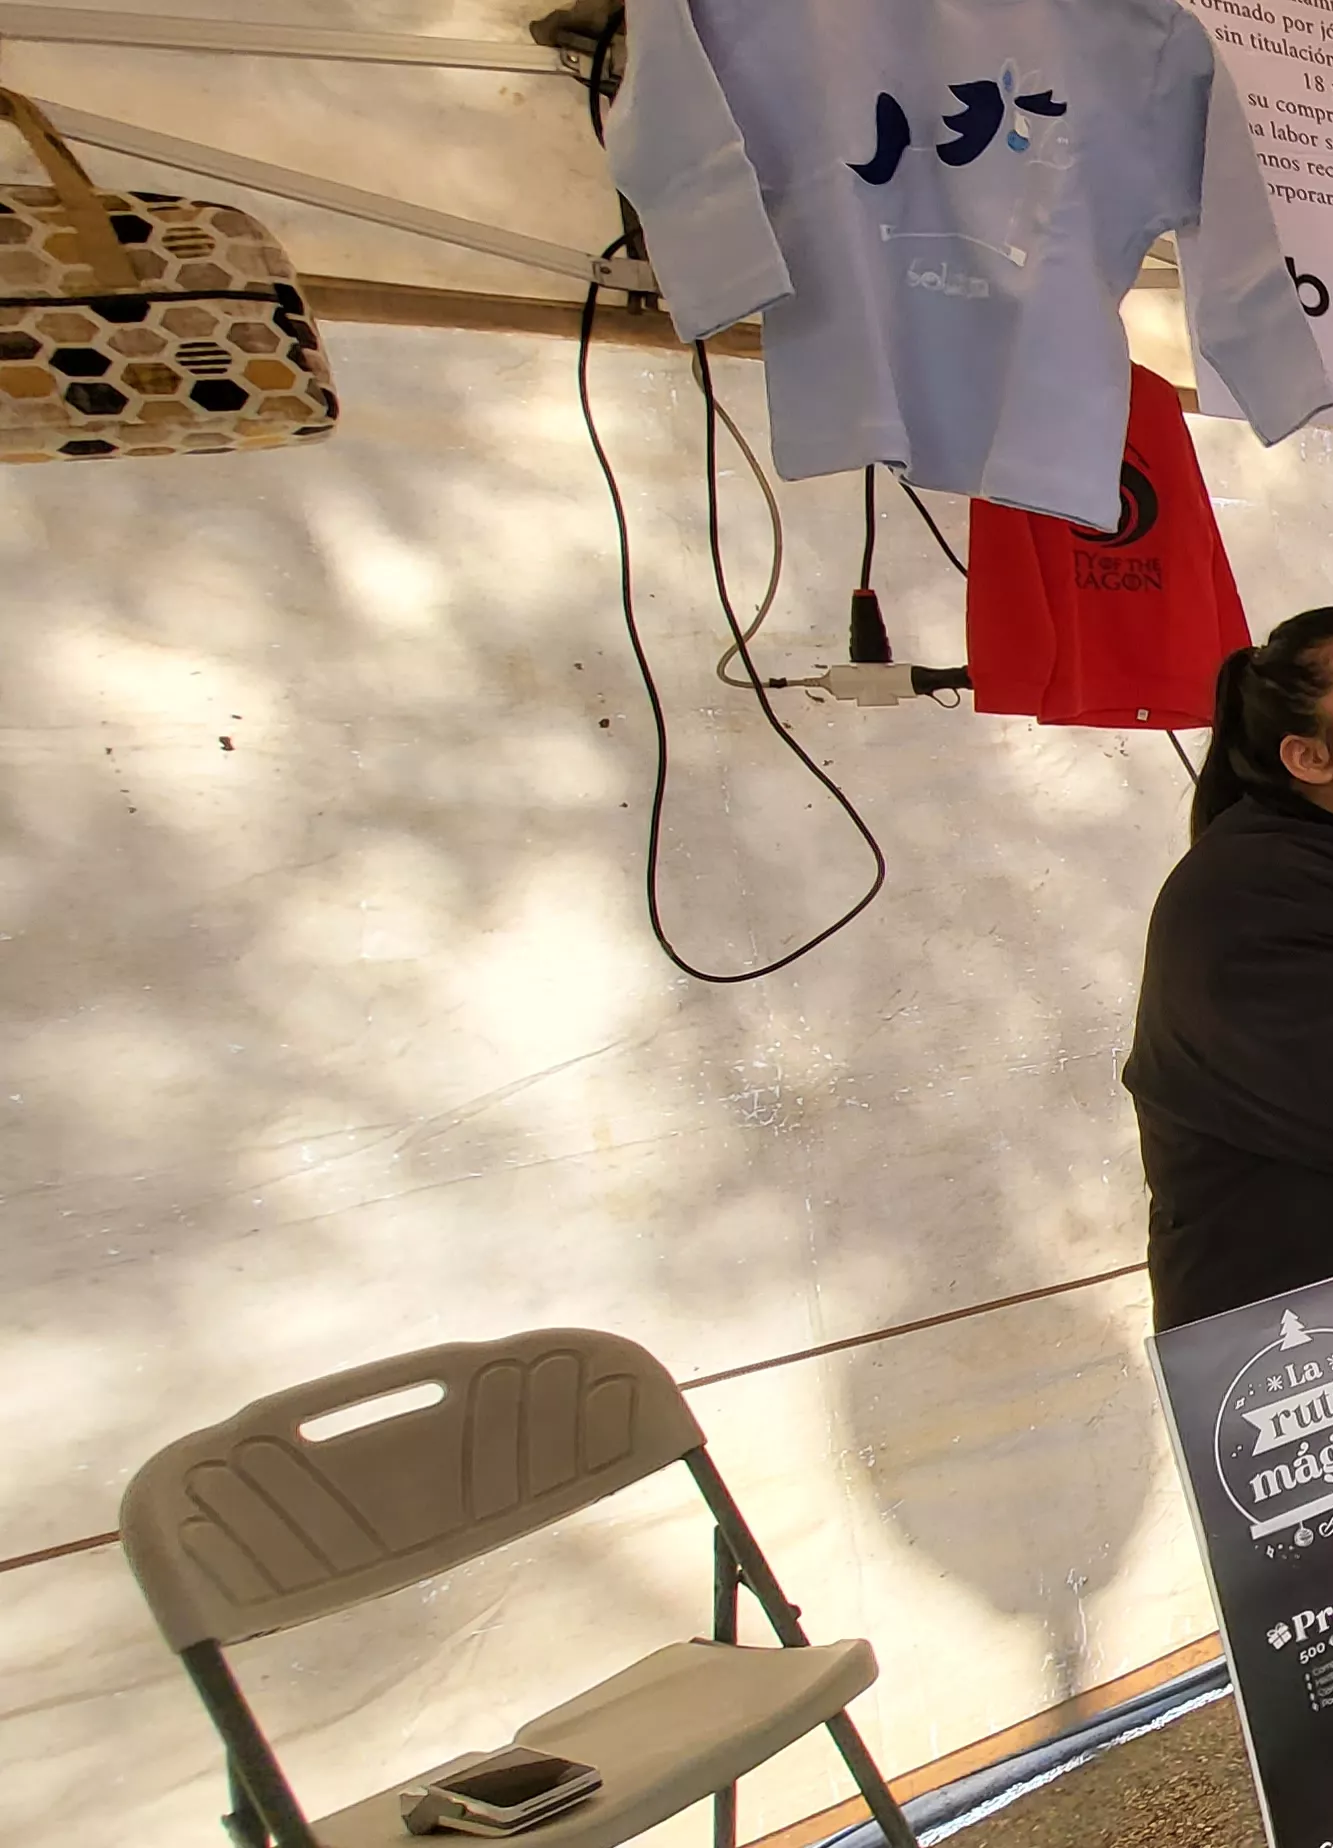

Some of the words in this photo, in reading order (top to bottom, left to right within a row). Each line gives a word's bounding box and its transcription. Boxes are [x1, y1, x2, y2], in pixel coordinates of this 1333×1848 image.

[1282, 15, 1314, 34] por
[1215, 25, 1244, 46] sin
[1303, 73, 1326, 93] 18
[1248, 92, 1270, 109] su
[1270, 121, 1319, 147] labor
[1285, 1361, 1323, 1388] La
[1300, 1642, 1326, 1664] 500
